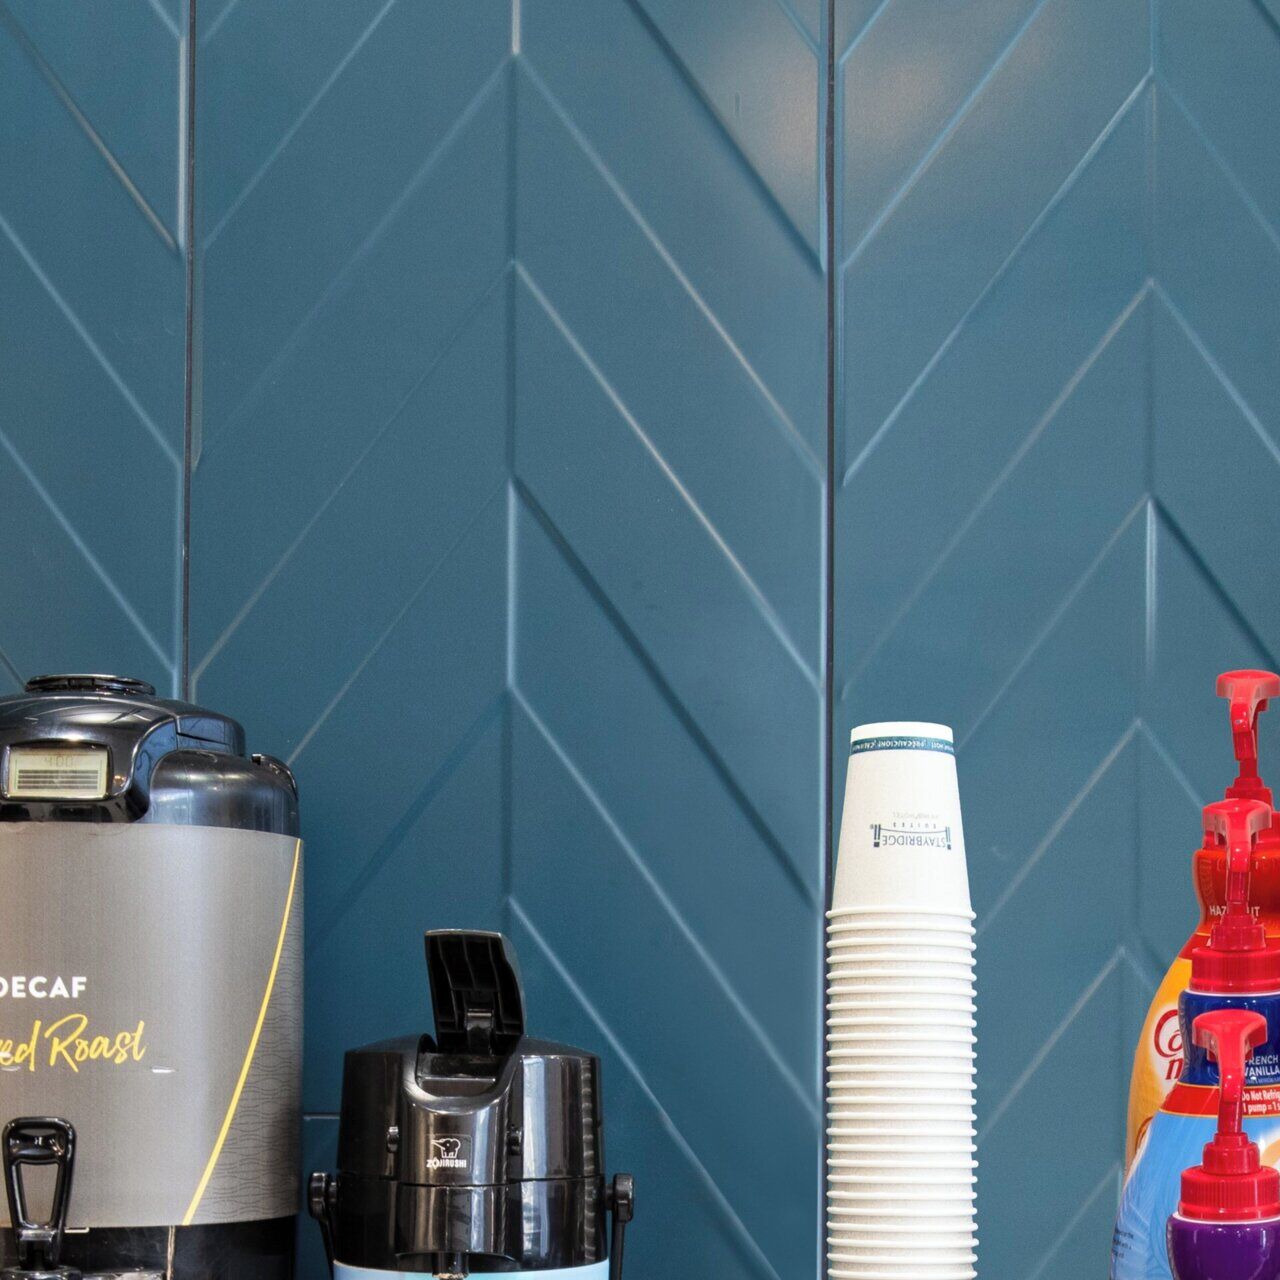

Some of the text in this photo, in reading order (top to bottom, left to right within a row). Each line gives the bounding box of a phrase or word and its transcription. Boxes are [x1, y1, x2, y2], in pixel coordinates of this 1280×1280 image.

[882, 835, 946, 848] STAYBRIDGE
[44, 1013, 149, 1073] Roast
[1251, 1090, 1262, 1101] Not
[1247, 1102, 1268, 1115] pump
[426, 1157, 467, 1170] ZOJIRUSHI
